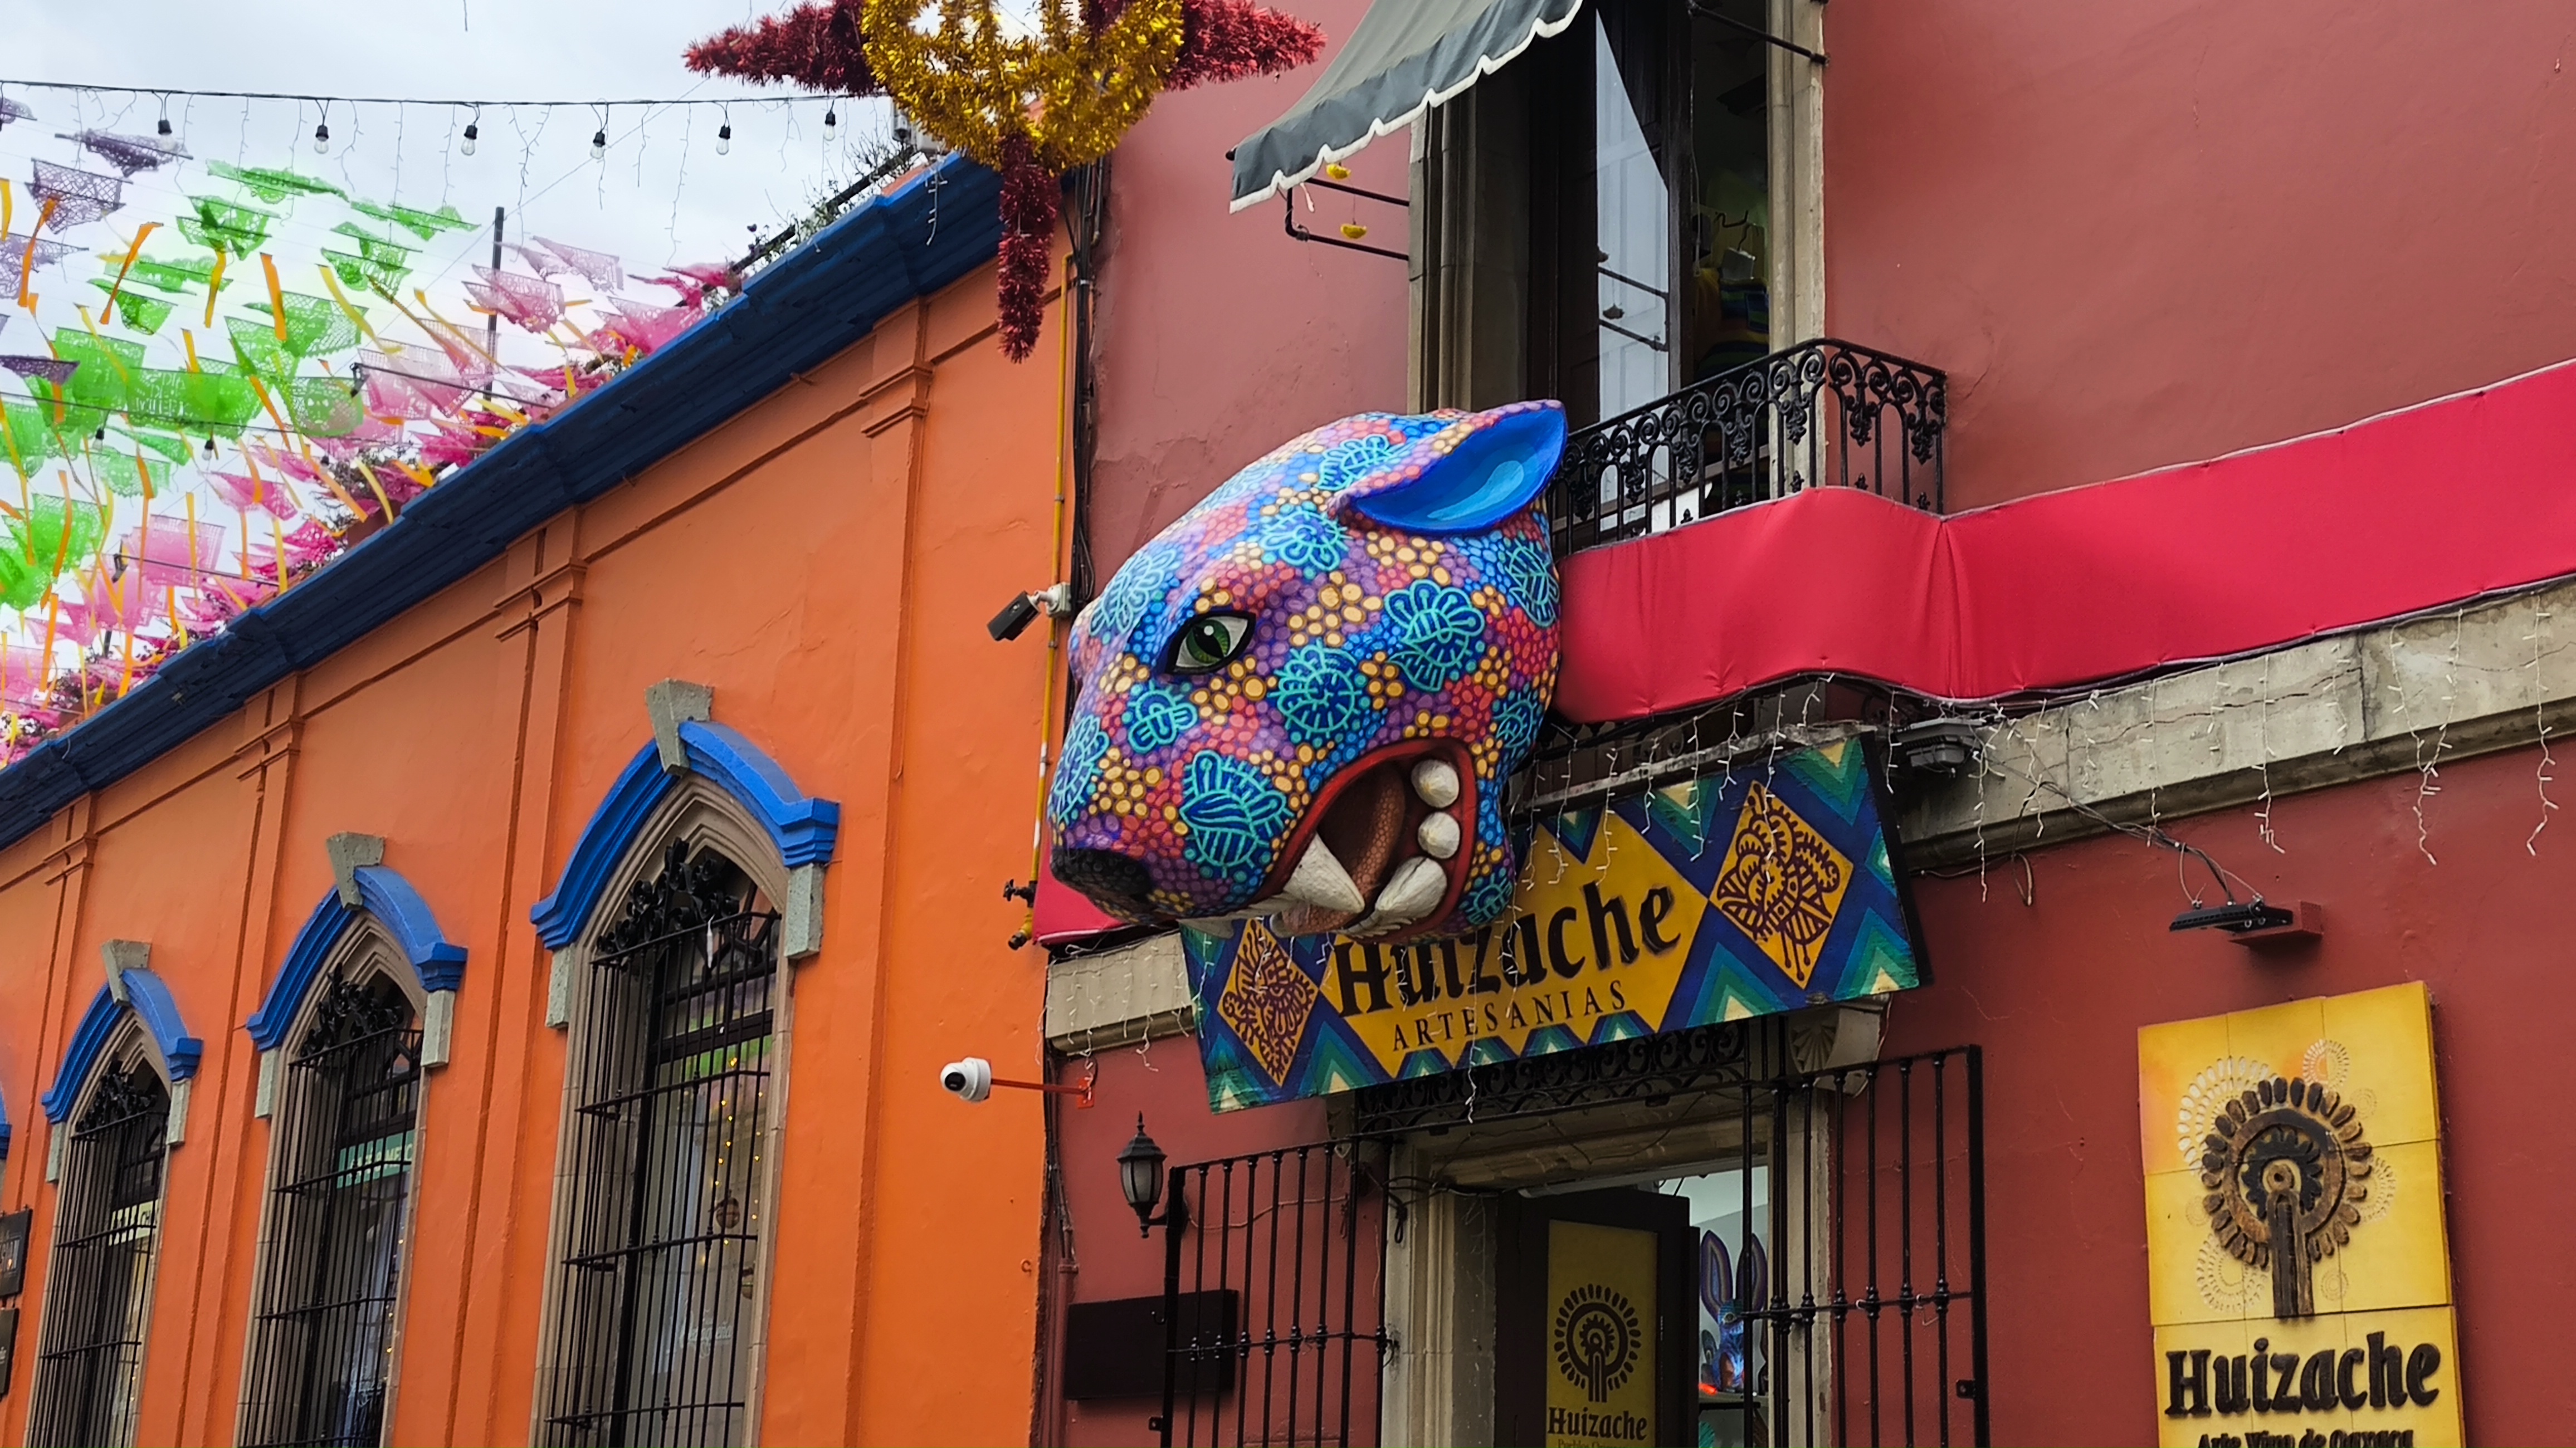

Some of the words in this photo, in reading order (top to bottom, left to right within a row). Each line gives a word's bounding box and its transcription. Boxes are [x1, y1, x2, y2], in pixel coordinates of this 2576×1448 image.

[1334, 881, 1681, 1017] Huizache
[1393, 980, 1626, 1051] ARTESANIAS
[2165, 1331, 2441, 1416] Huizache
[1547, 1407, 1647, 1441] Huizache
